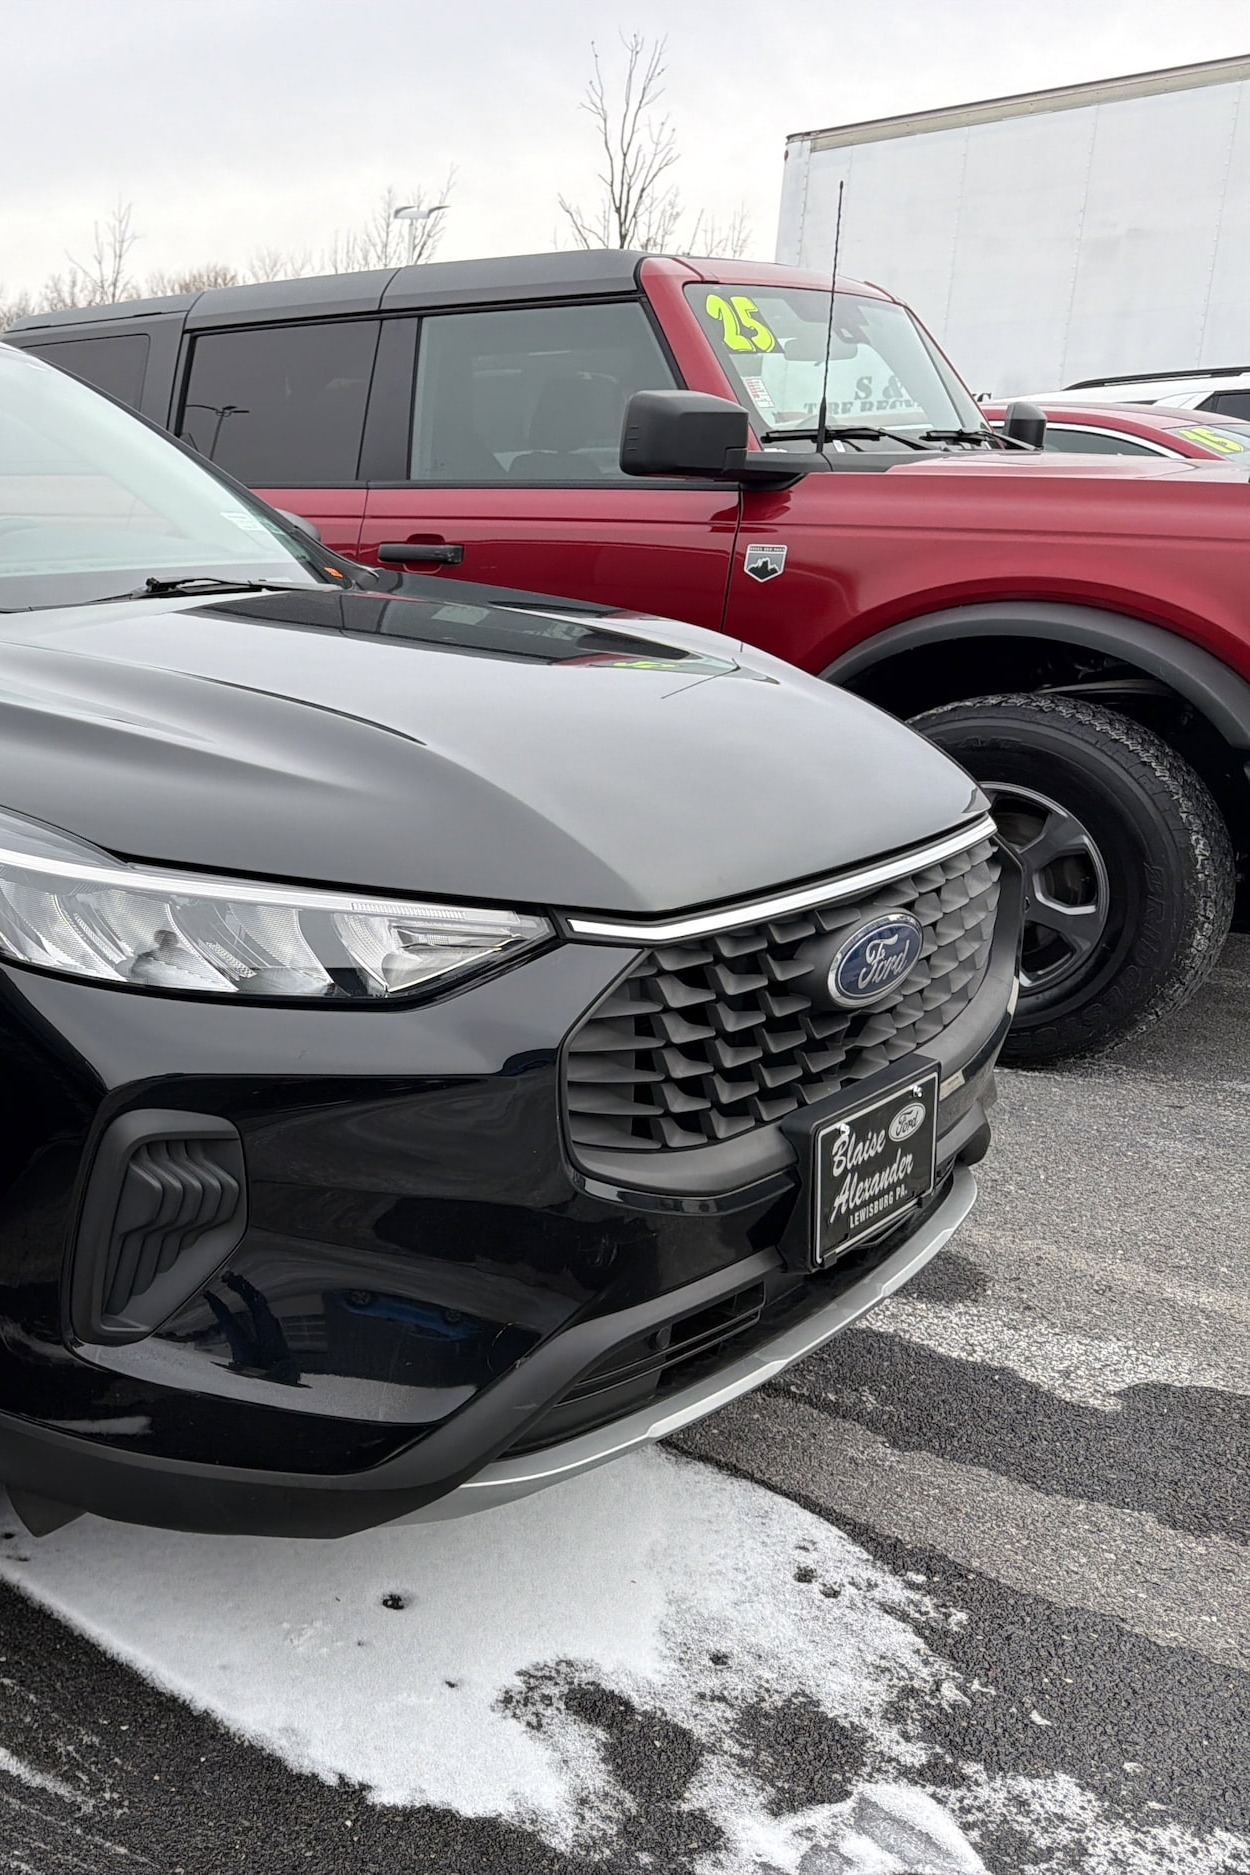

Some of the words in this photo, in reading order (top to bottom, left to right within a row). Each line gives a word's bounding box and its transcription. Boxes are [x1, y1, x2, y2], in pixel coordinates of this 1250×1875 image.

[706, 294, 776, 352] 25
[803, 401, 854, 415] TRE
[858, 933, 910, 989] Ford
[832, 1129, 886, 1177] Blaise
[830, 1148, 913, 1223] Alexander
[850, 1192, 894, 1228] LEWISBURG
[895, 1183, 908, 1200] PA.
